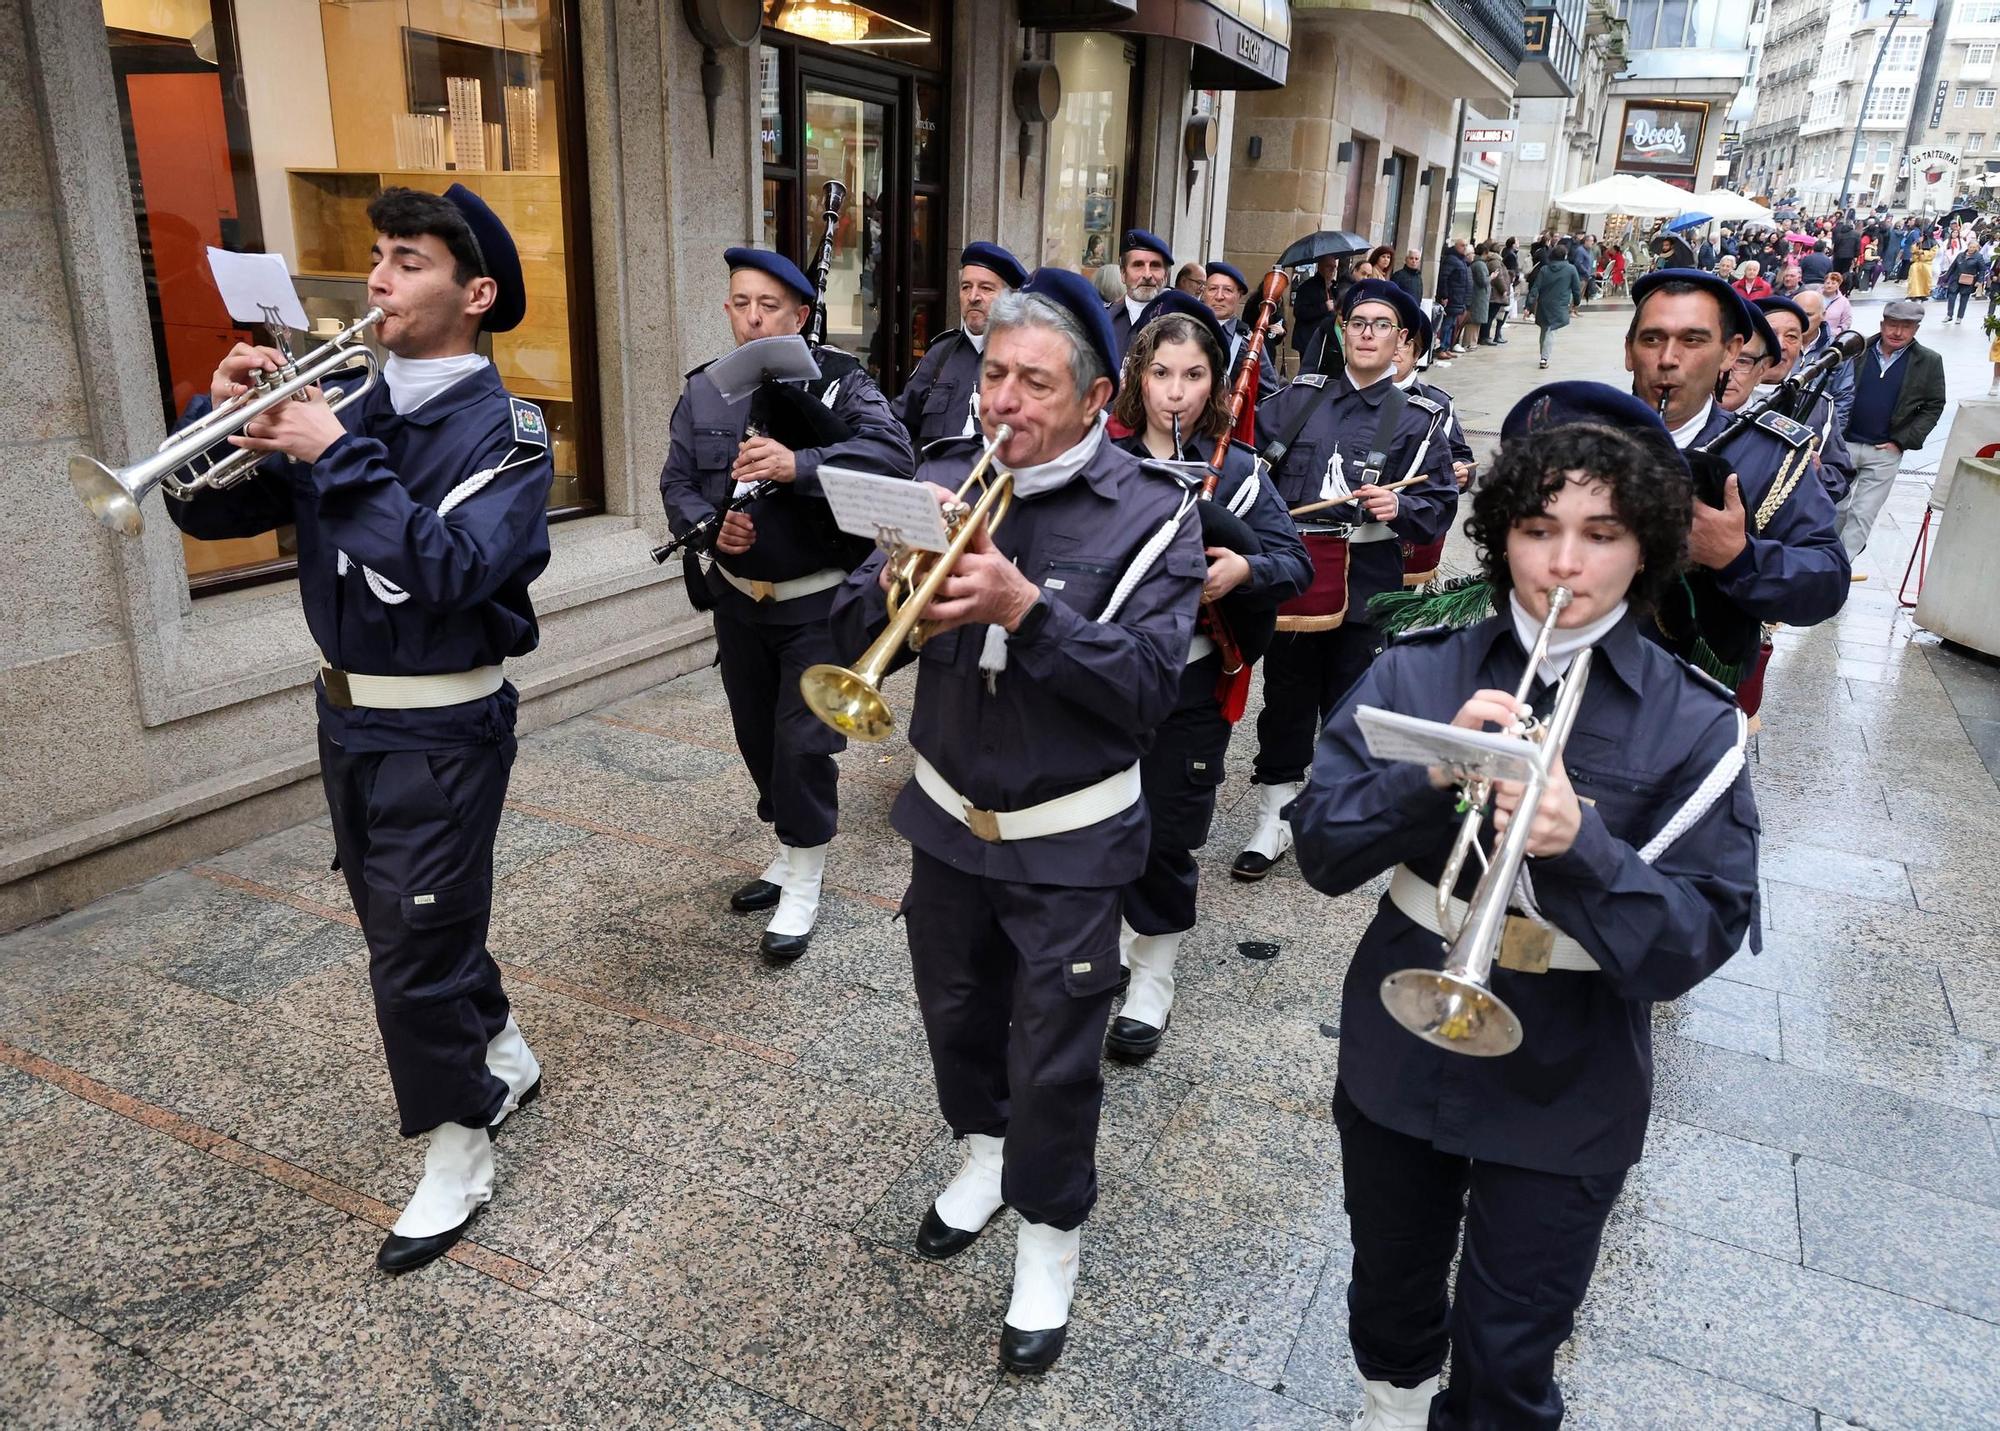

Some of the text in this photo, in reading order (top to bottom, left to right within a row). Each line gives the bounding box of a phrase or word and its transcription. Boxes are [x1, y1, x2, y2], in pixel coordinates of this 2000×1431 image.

[1933, 80, 1947, 122] HOTEL
[1632, 119, 1686, 154] Dooers
[1911, 155, 1921, 165] OS
